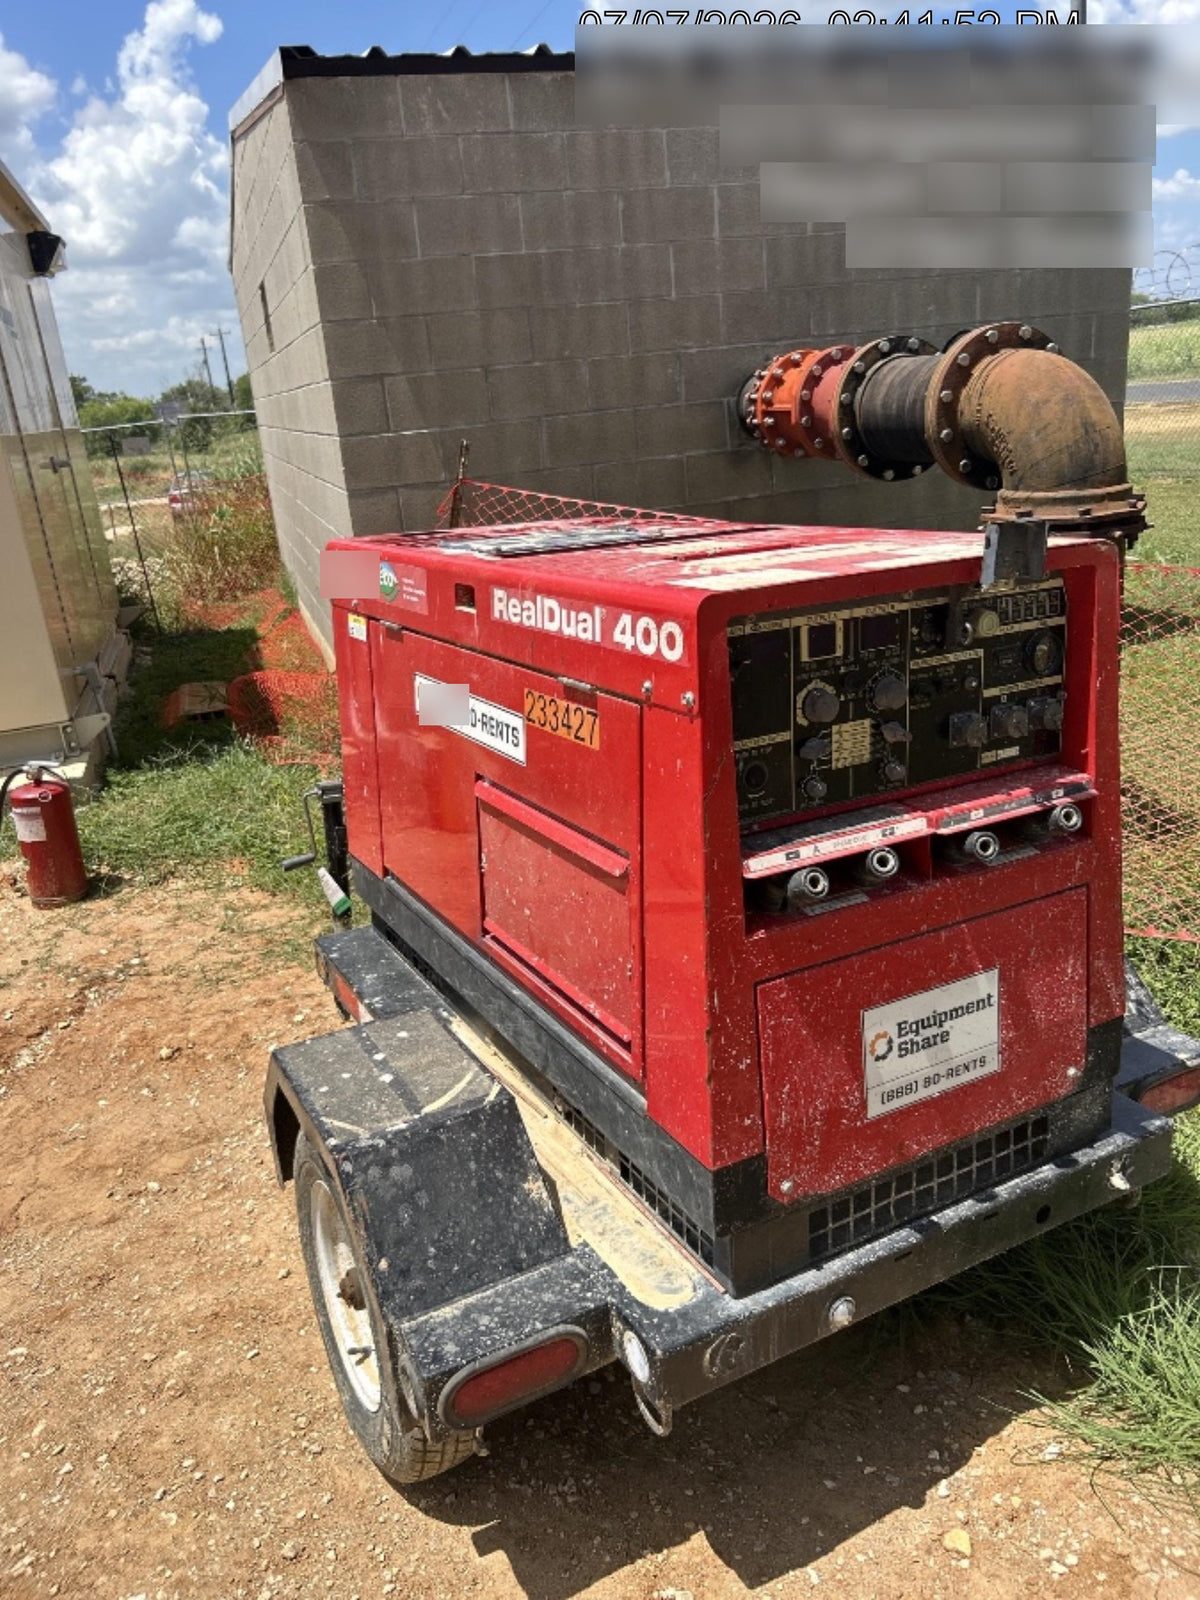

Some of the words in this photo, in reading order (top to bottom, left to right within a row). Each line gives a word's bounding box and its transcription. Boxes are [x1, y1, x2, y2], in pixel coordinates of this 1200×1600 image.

[613, 613, 684, 662] 400
[470, 707, 520, 747] 0-RENTS
[525, 690, 599, 746] 233427
[896, 992, 995, 1039] Equipment
[897, 1029, 950, 1059] Share
